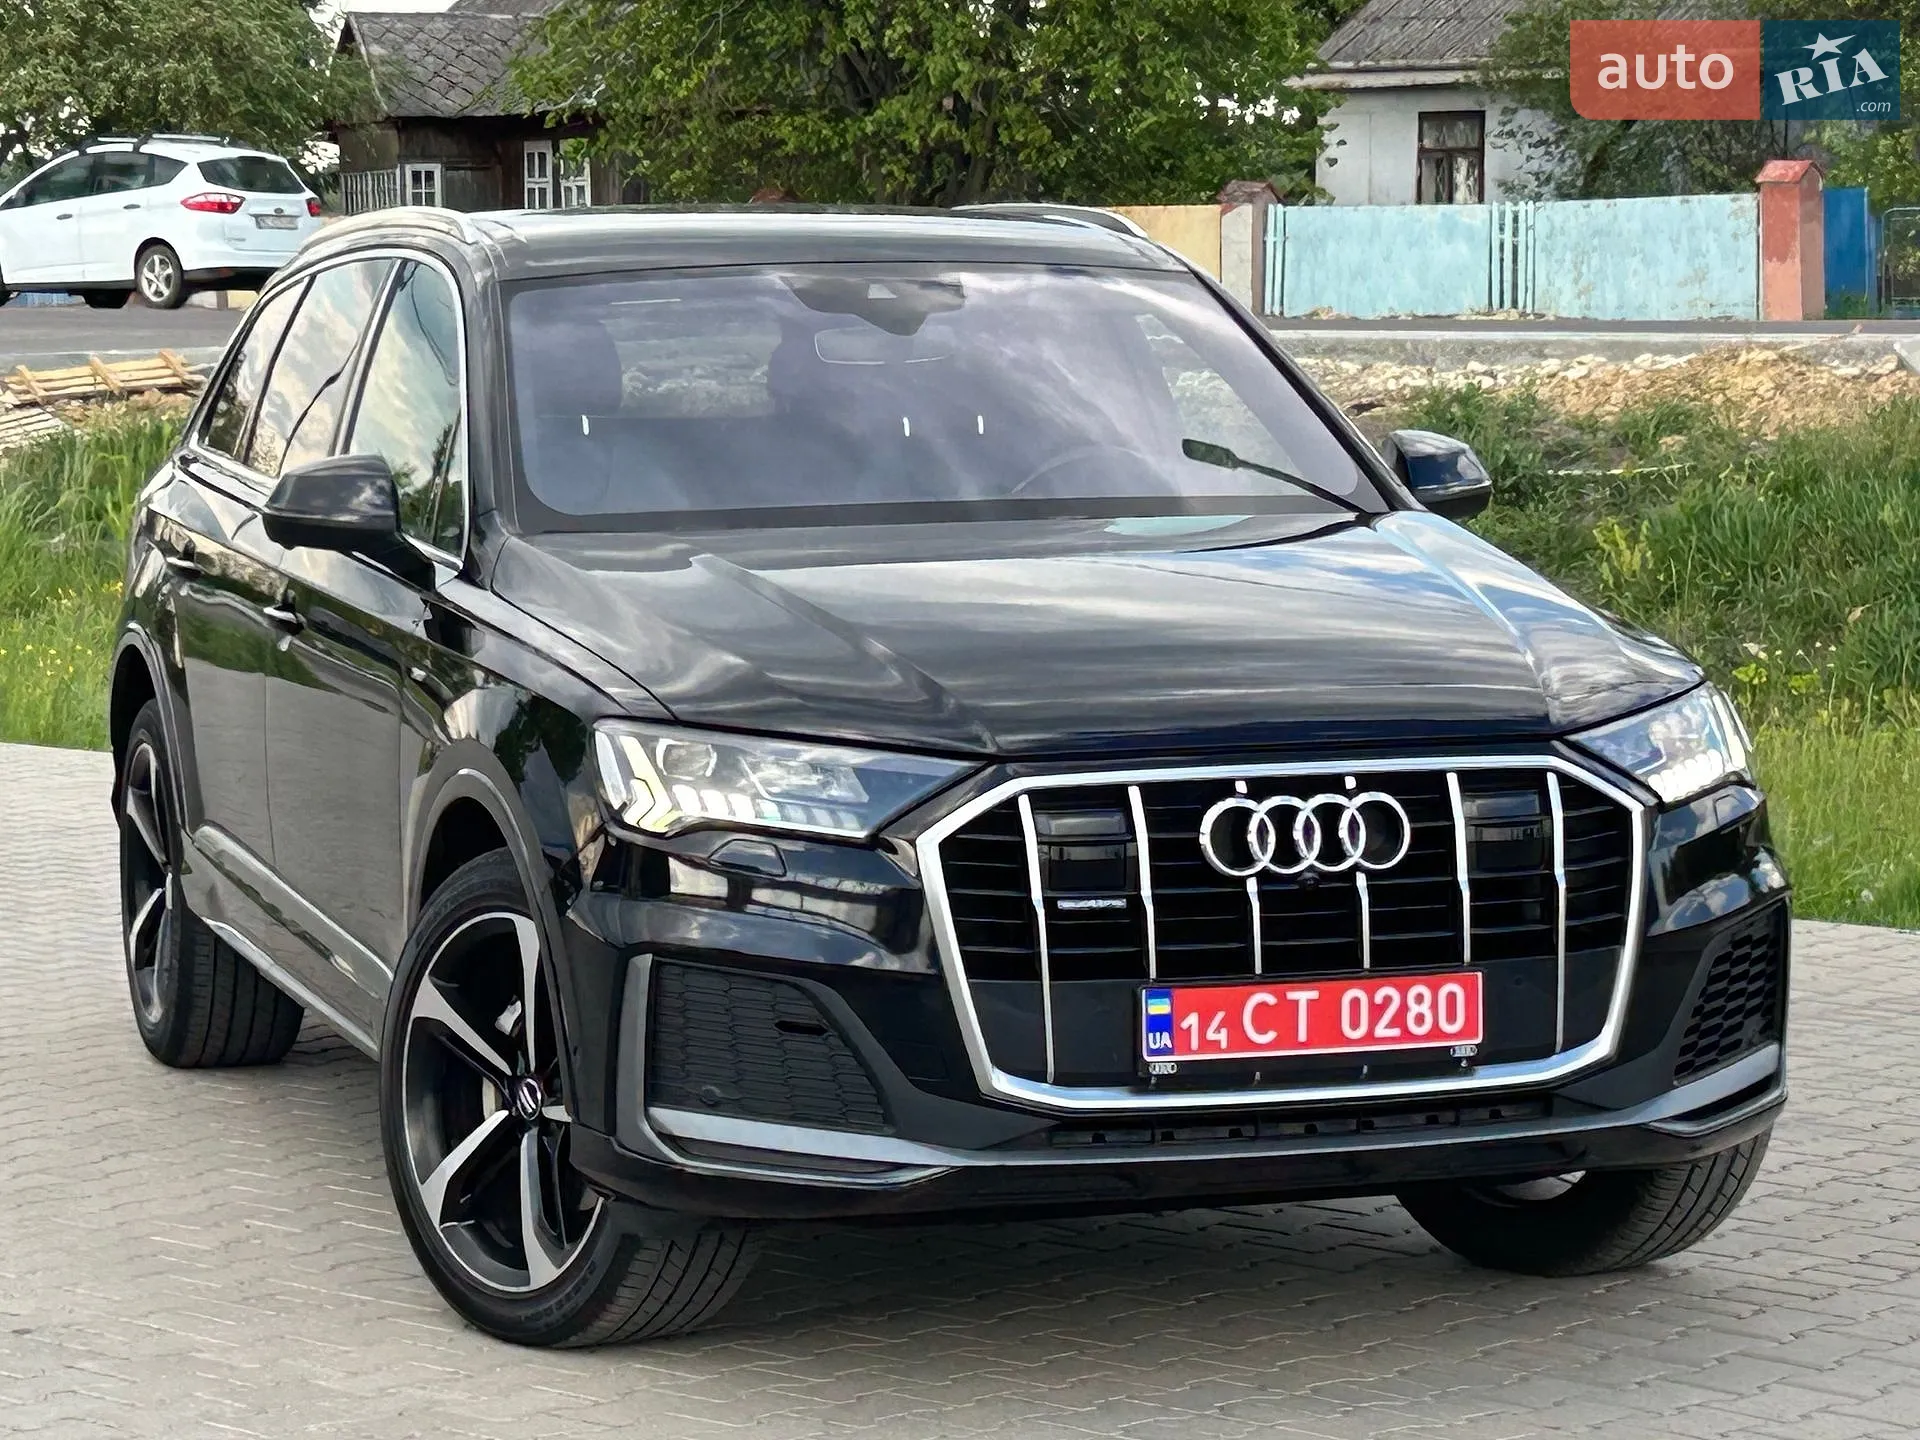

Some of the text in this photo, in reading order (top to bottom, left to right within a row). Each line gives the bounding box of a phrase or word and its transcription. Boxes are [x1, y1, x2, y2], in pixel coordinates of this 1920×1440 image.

[1180, 983, 1466, 1051] 14 CT 0280
[1148, 1032, 1172, 1050] UA
